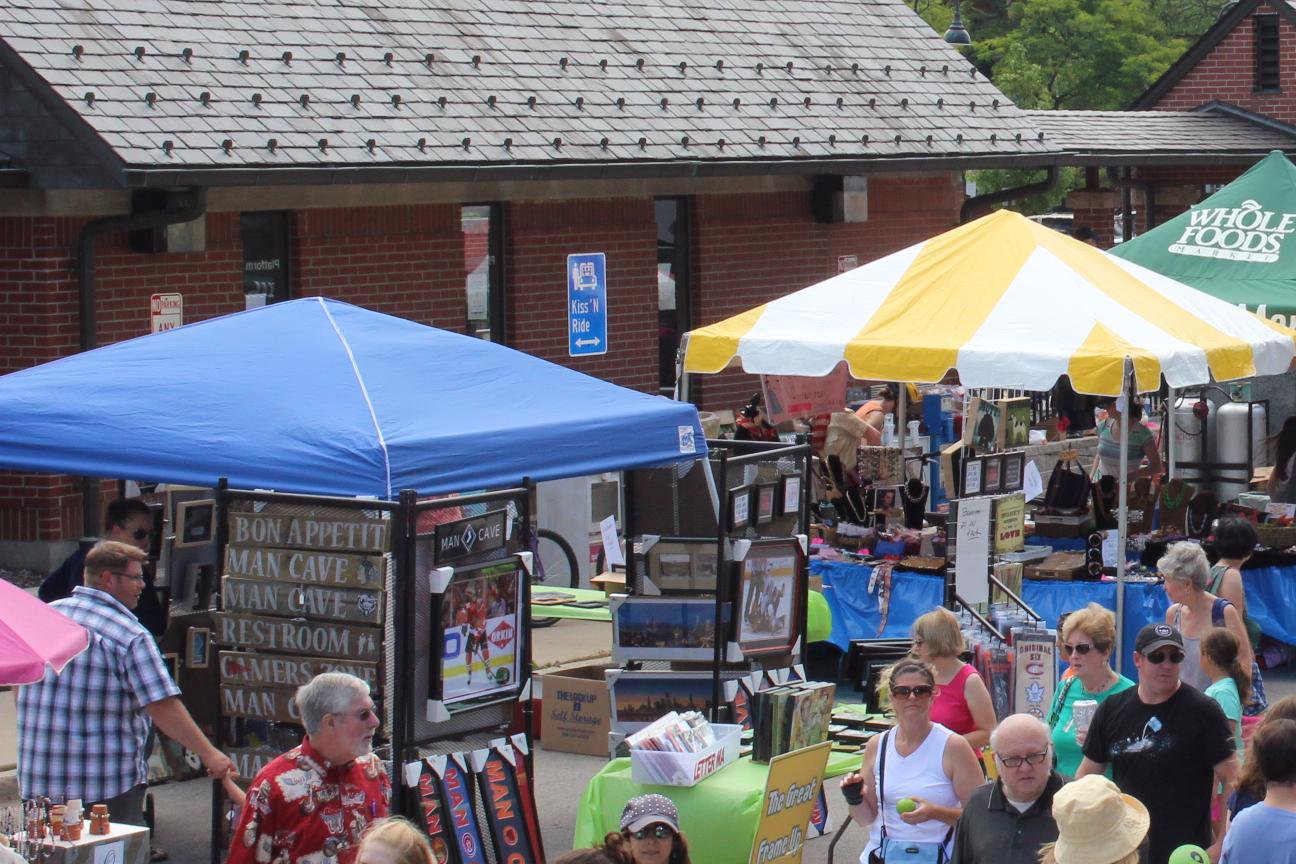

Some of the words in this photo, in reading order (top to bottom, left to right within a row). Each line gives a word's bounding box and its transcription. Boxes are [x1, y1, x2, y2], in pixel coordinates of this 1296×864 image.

[1176, 226, 1285, 254] FOODS
[572, 299, 589, 314] Kiss
[572, 318, 590, 333] Ride
[235, 517, 281, 543] BON
[287, 519, 385, 549] APPETIT
[441, 535, 460, 550] MAN
[478, 524, 500, 541] CAVE
[229, 548, 280, 577] MAN
[289, 553, 349, 583] CAVE
[225, 583, 279, 610] MAN
[287, 587, 347, 618] CAVE
[222, 618, 350, 654] RESTROOM
[224, 688, 276, 716] MAN
[693, 755, 716, 781] LETTER
[419, 773, 443, 835] MAN
[444, 768, 470, 828] MAN
[486, 760, 515, 820] MAN
[767, 789, 785, 816] The
[785, 777, 817, 808] Great
[758, 838, 789, 864] Frame
